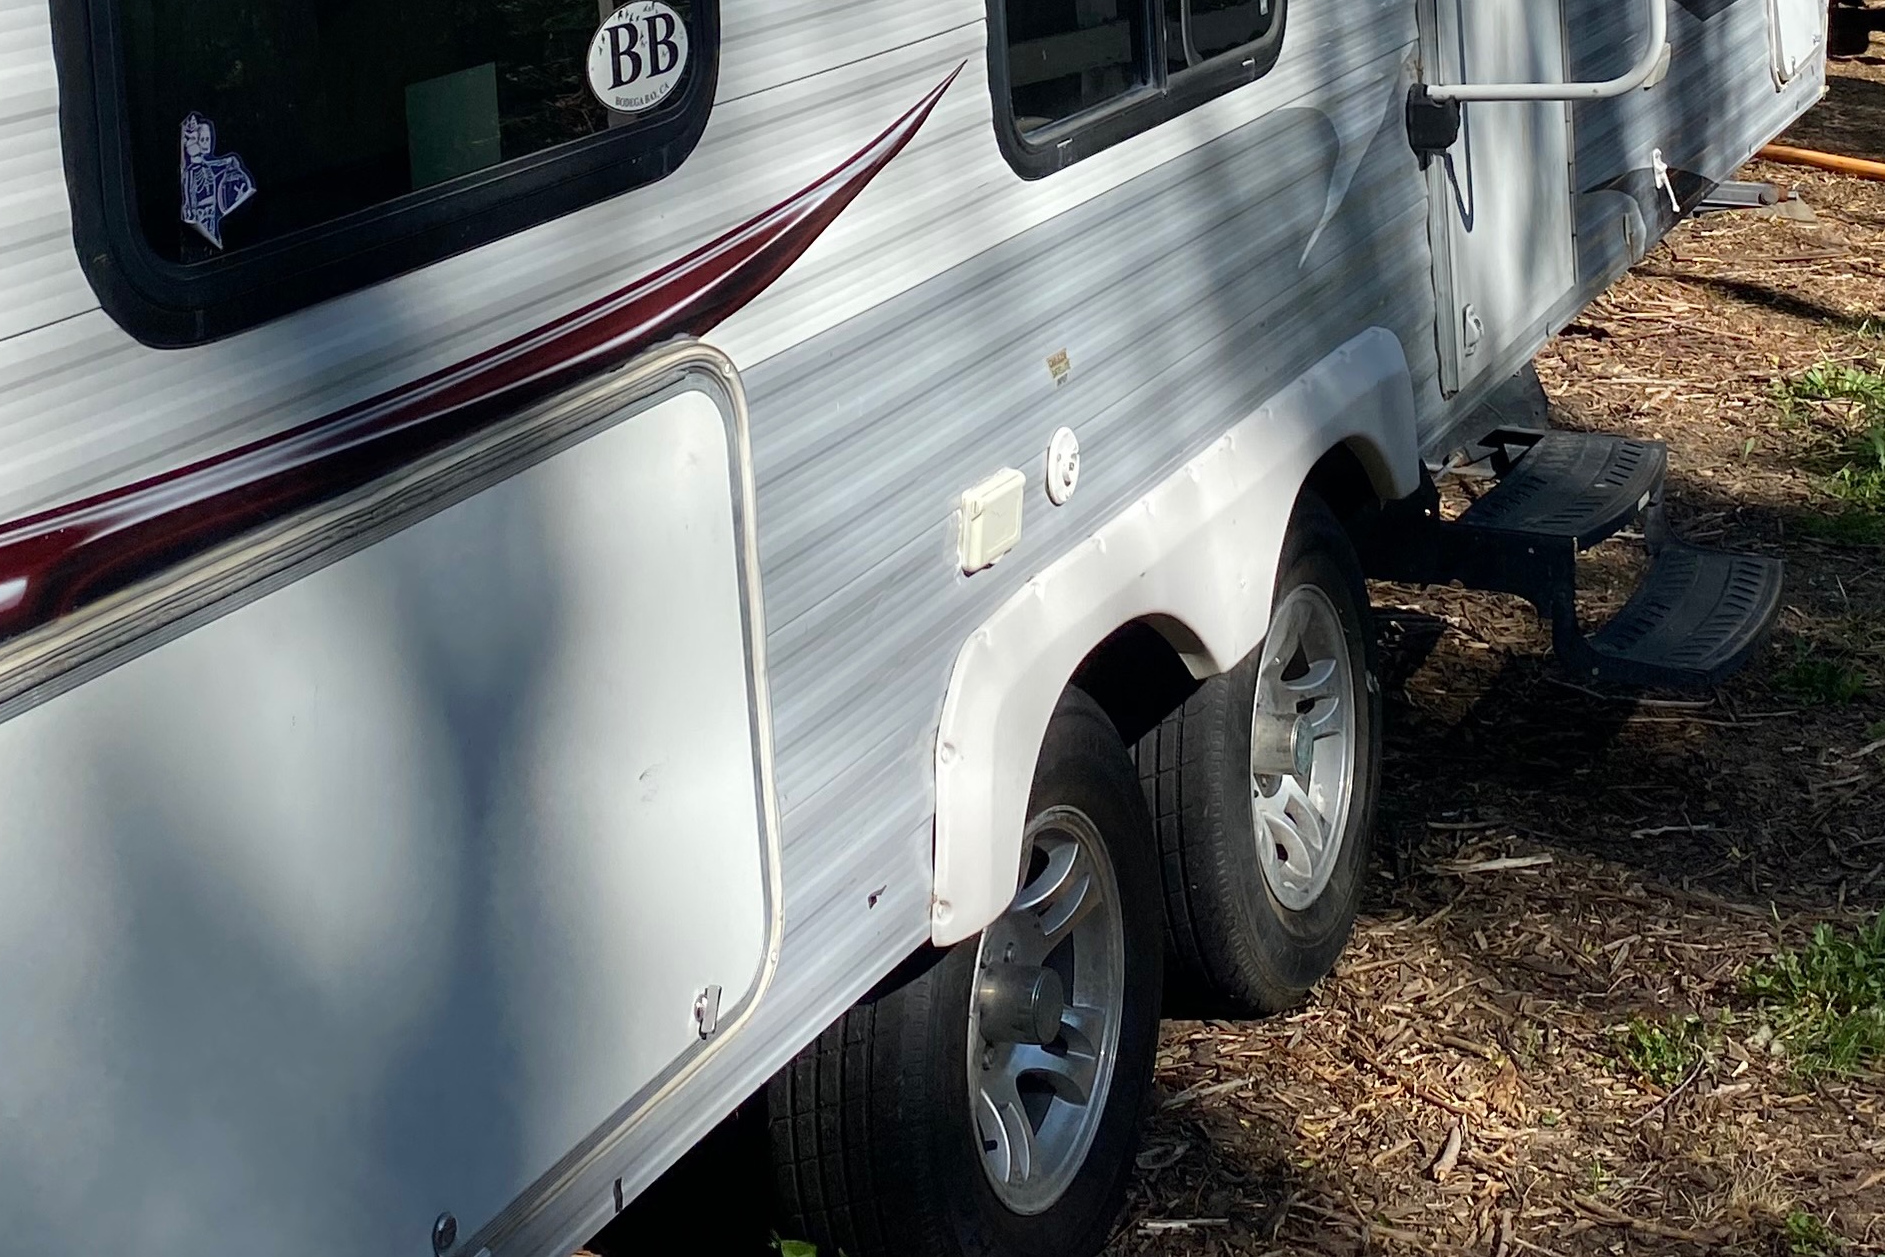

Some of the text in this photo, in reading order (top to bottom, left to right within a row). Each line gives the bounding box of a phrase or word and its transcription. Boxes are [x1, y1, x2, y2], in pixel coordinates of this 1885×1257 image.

[603, 12, 679, 91] BB
[615, 96, 645, 107] BODEGA
[659, 82, 670, 94] CA
